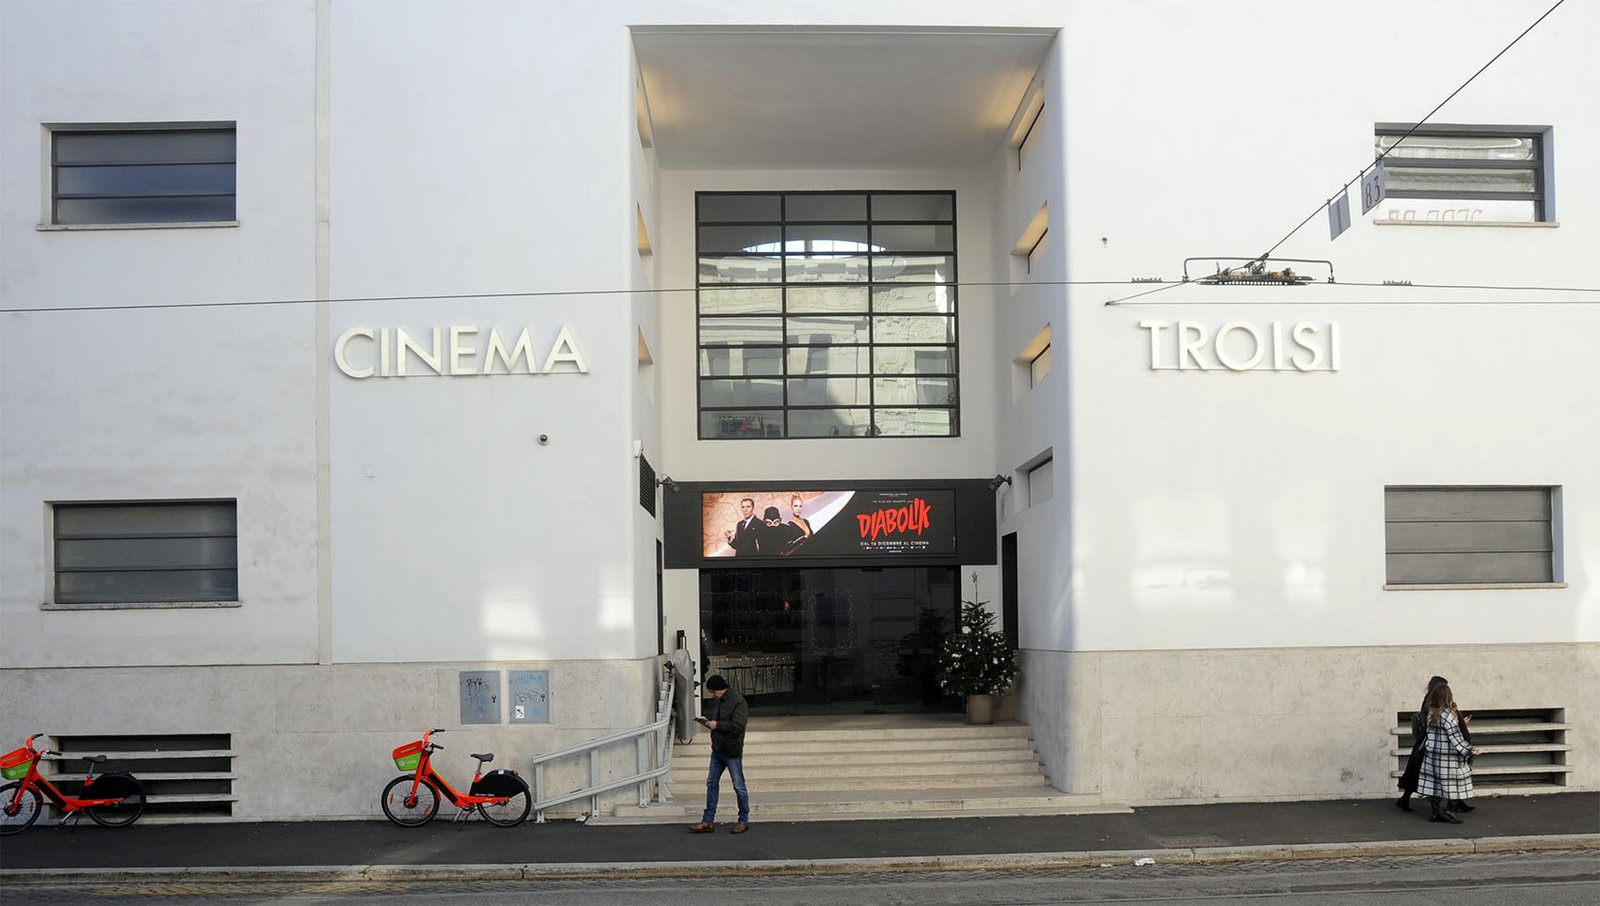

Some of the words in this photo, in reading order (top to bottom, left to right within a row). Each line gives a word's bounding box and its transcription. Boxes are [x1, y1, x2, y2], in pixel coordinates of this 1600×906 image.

[334, 324, 590, 379] CINEMA
[1137, 319, 1341, 372] TROISI
[856, 497, 932, 542] DIABOLIK
